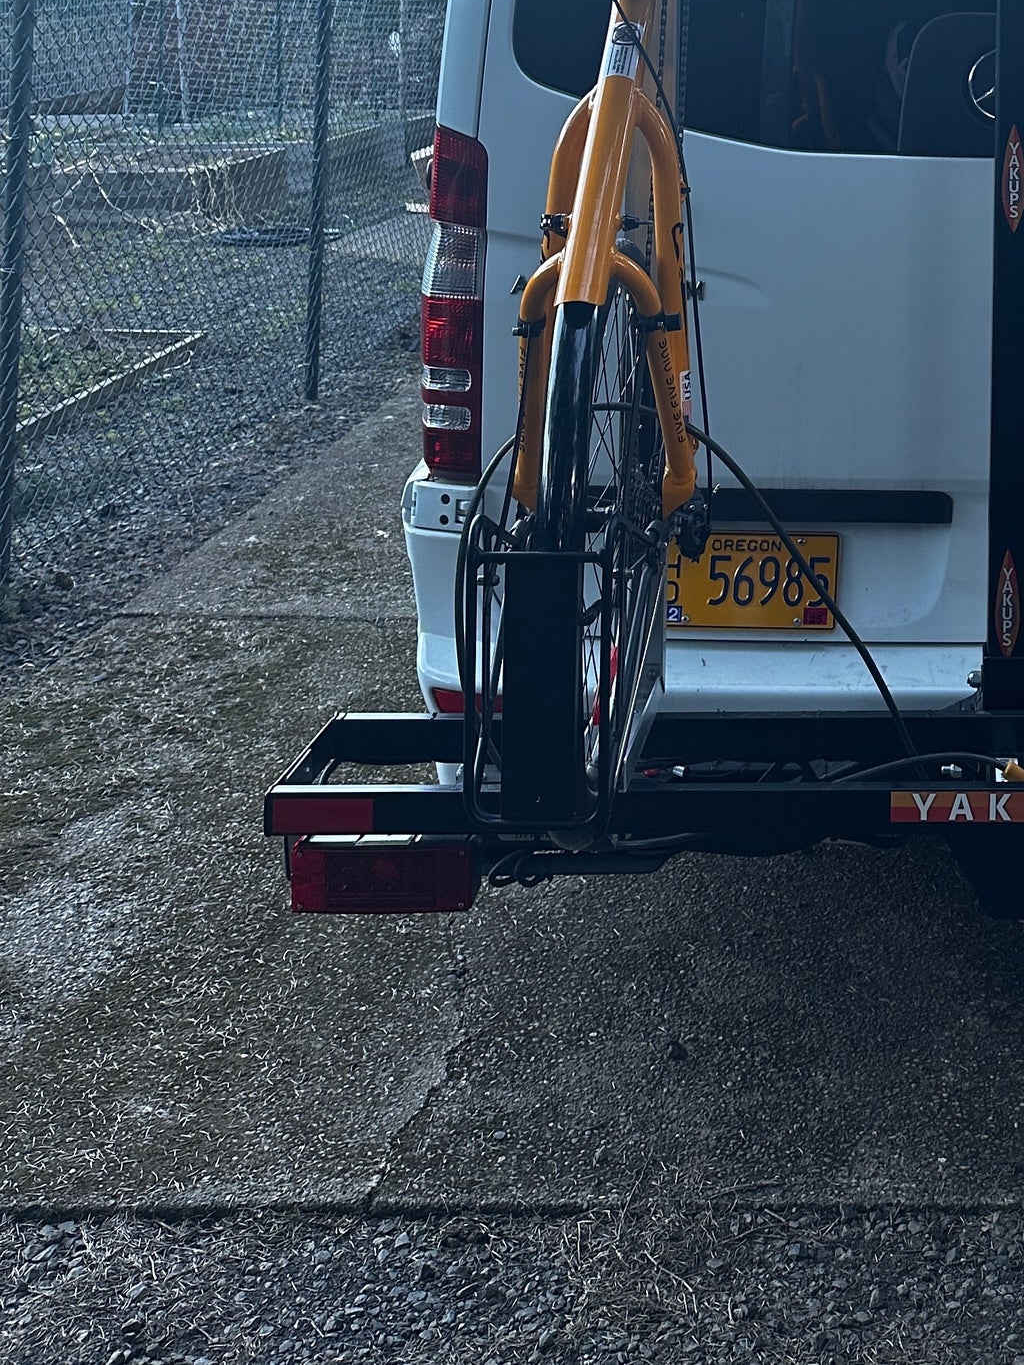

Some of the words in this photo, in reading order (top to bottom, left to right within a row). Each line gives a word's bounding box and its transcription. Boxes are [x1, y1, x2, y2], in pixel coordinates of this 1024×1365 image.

[1008, 142, 1020, 219] YAKUPS
[658, 337, 673, 372] NINE
[666, 374, 678, 408] FIVE
[672, 410, 686, 443] FIVE
[711, 539, 782, 553] OREGON
[706, 555, 831, 607] 56985
[1001, 567, 1014, 647] YAKUPS
